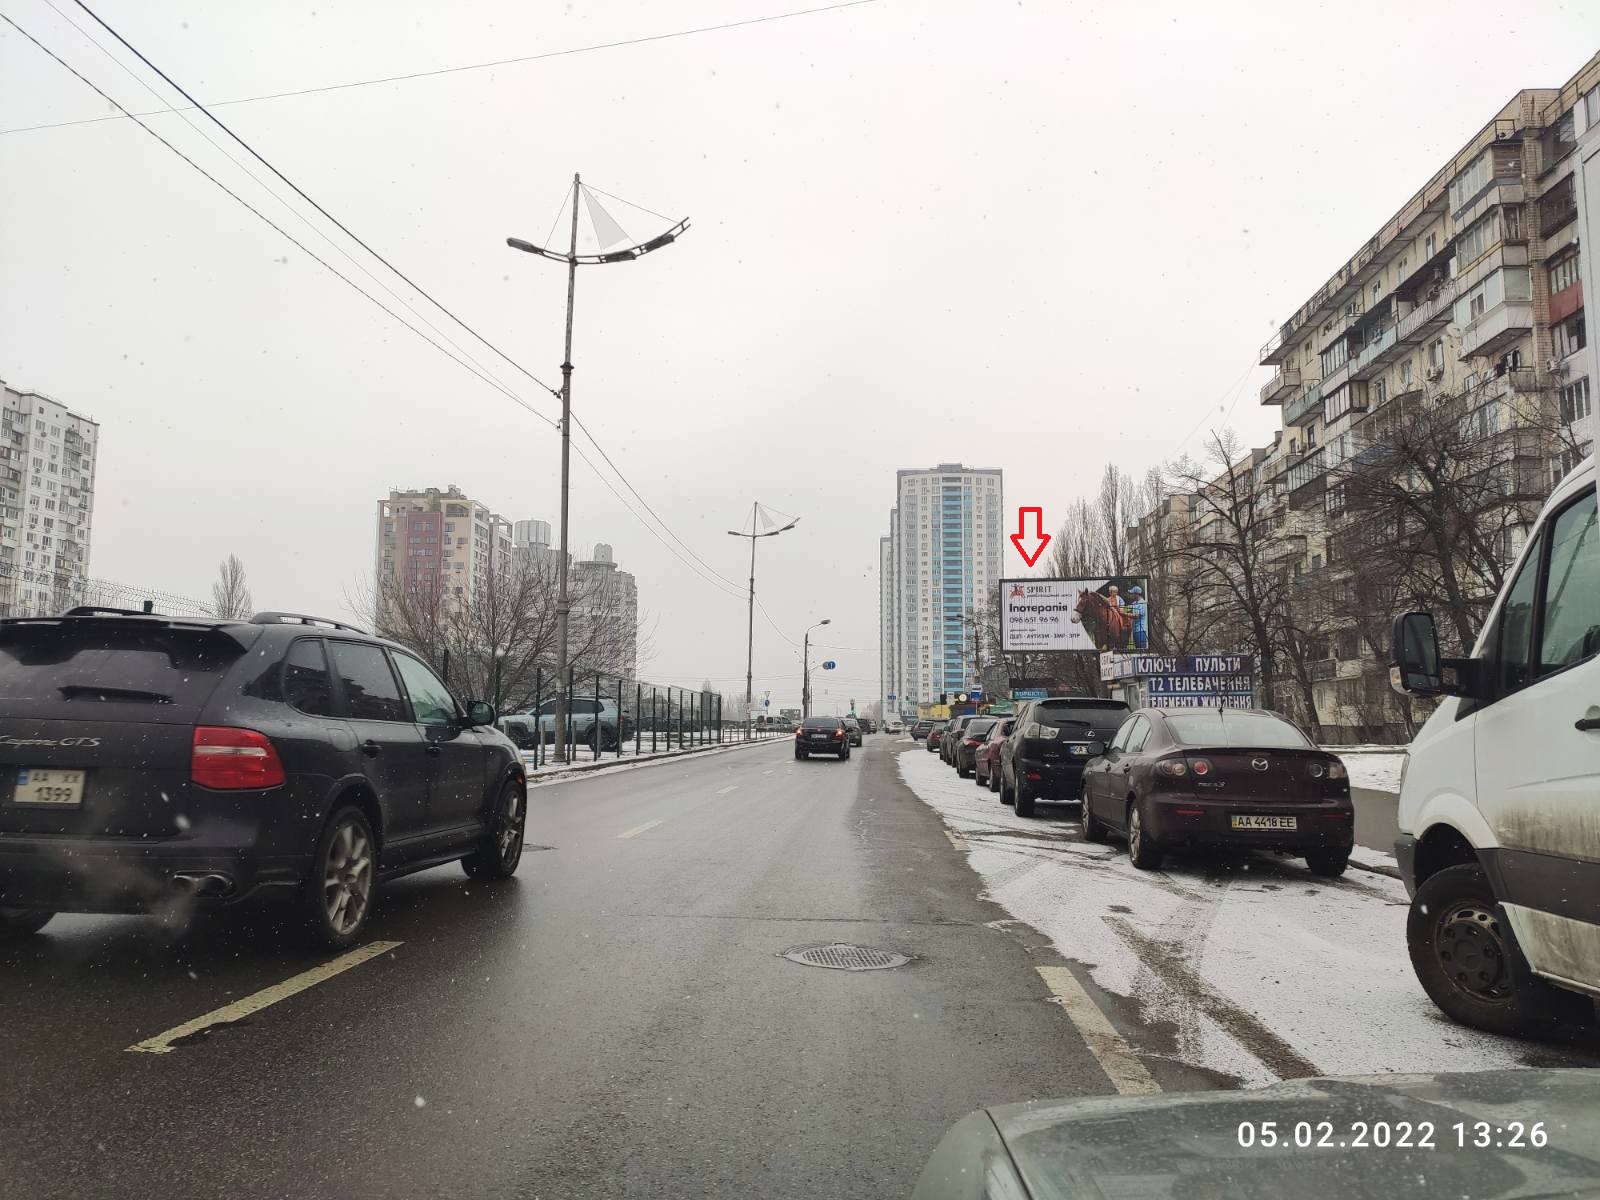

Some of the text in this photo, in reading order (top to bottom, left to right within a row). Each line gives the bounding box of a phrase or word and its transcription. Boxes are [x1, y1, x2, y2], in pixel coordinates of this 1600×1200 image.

[1009, 602, 1068, 614] Іпотерапія
[1138, 656, 1177, 673] КЛЮЧІ
[1195, 657, 1241, 672] ПУЛЬТИ
[1151, 676, 1251, 691] Т2 ТЕЛЕБАЧЕННЯ
[59, 737, 102, 747] GTS
[34, 787, 73, 802] 1399
[1238, 817, 1295, 828] AA 4418 EE
